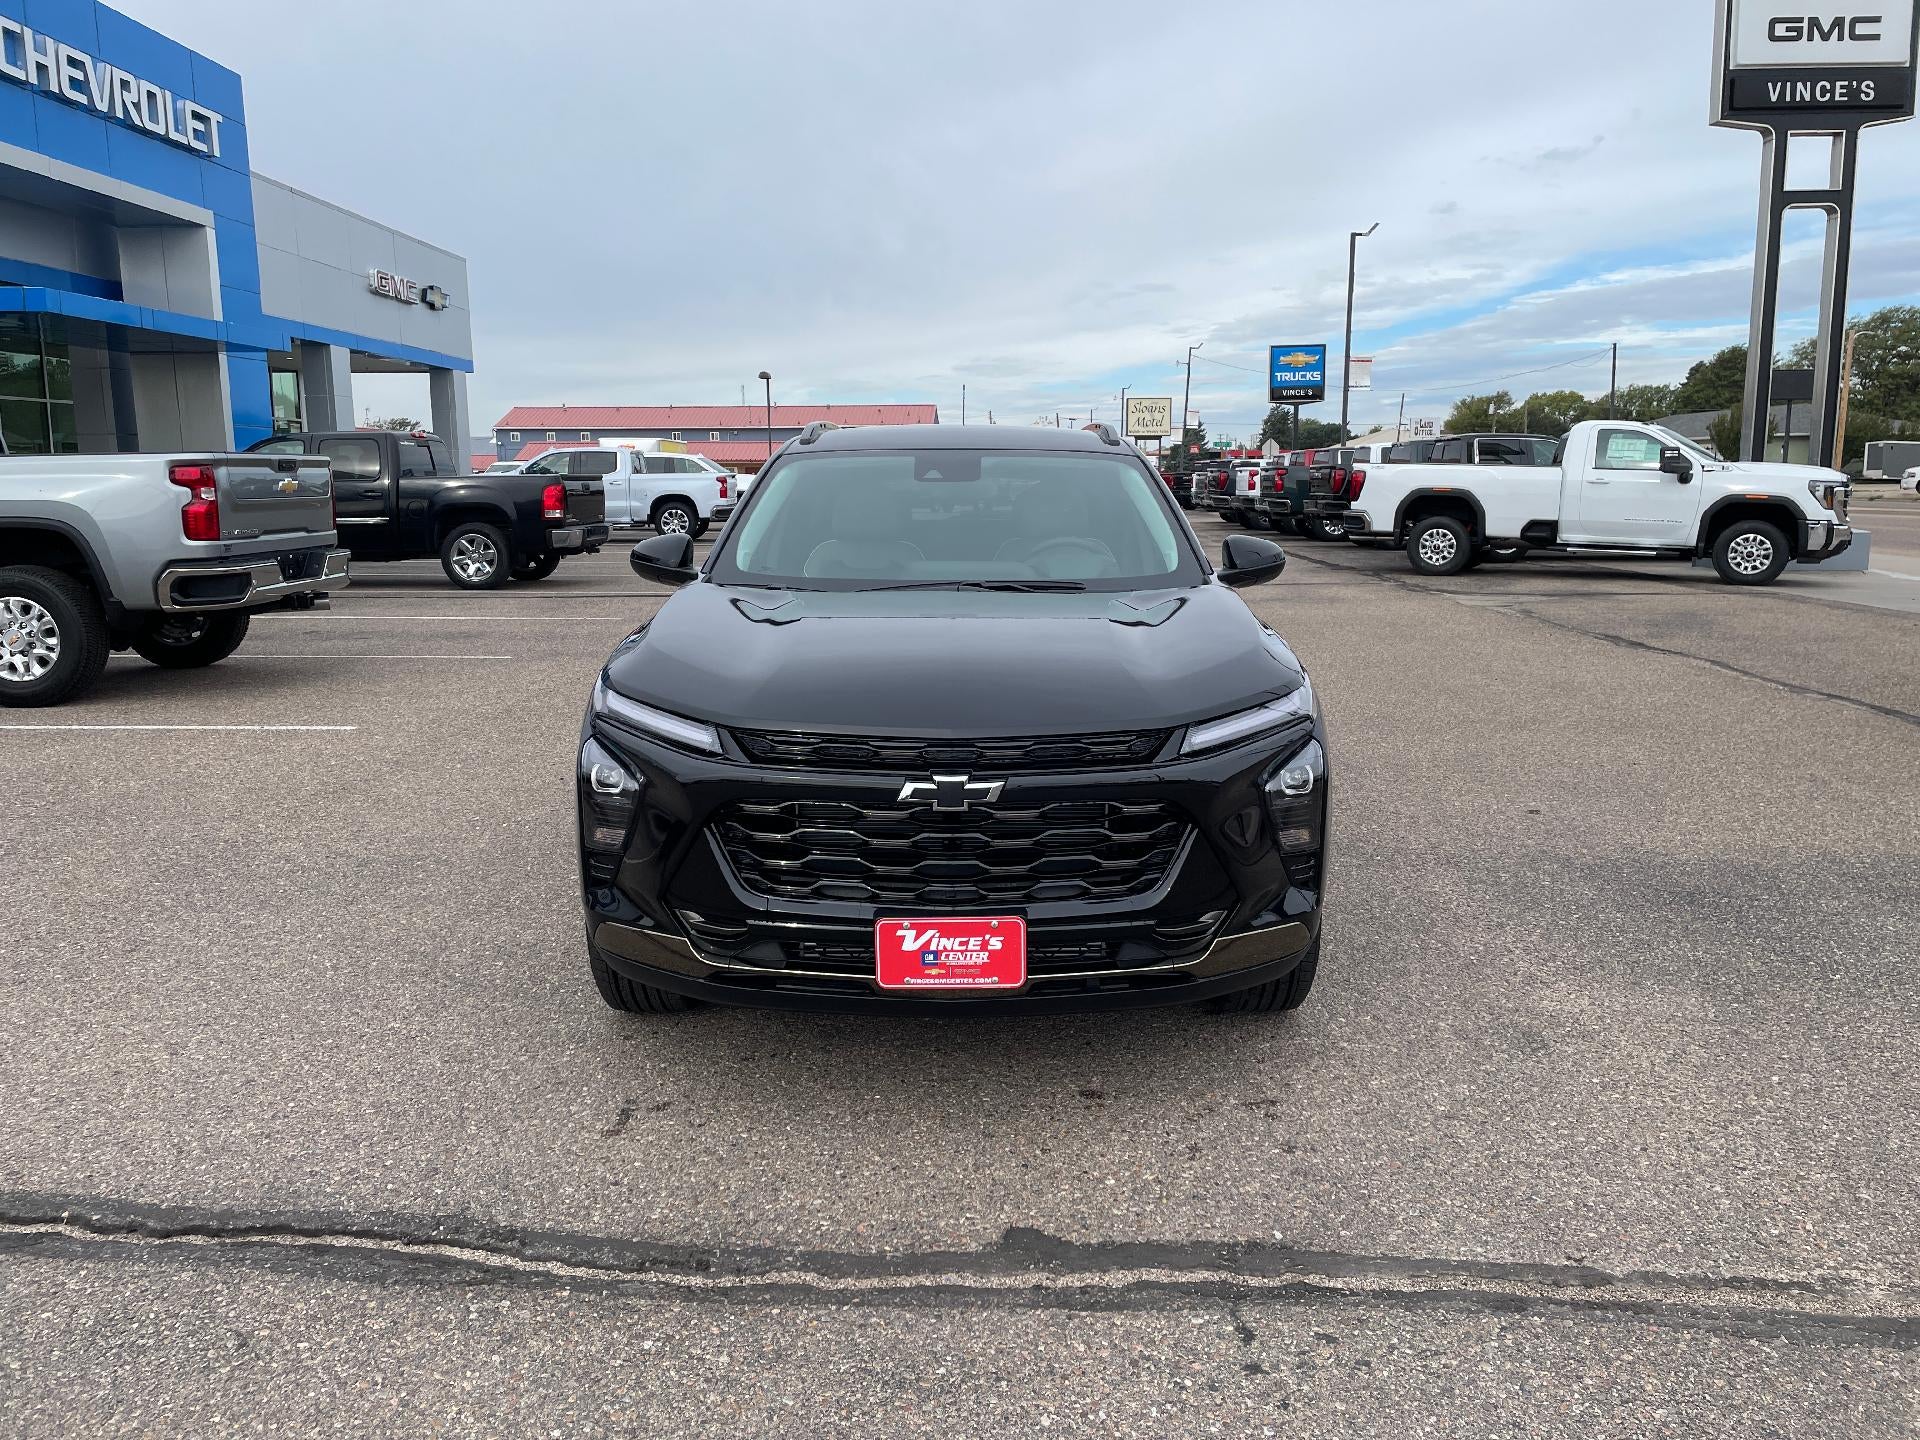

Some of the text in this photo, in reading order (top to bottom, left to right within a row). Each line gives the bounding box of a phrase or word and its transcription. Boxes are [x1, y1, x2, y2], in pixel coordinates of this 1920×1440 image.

[1767, 15, 1883, 42] GMC
[0, 15, 223, 158] CHEVROLET
[1767, 80, 1876, 103] VINCE'S
[370, 268, 420, 305] GMC
[1274, 371, 1321, 382] TRUCKS
[1282, 388, 1313, 397] VINCE'S
[1131, 401, 1167, 414] Sloans
[1132, 414, 1165, 428] Motel
[924, 951, 990, 961] GM CENTER
